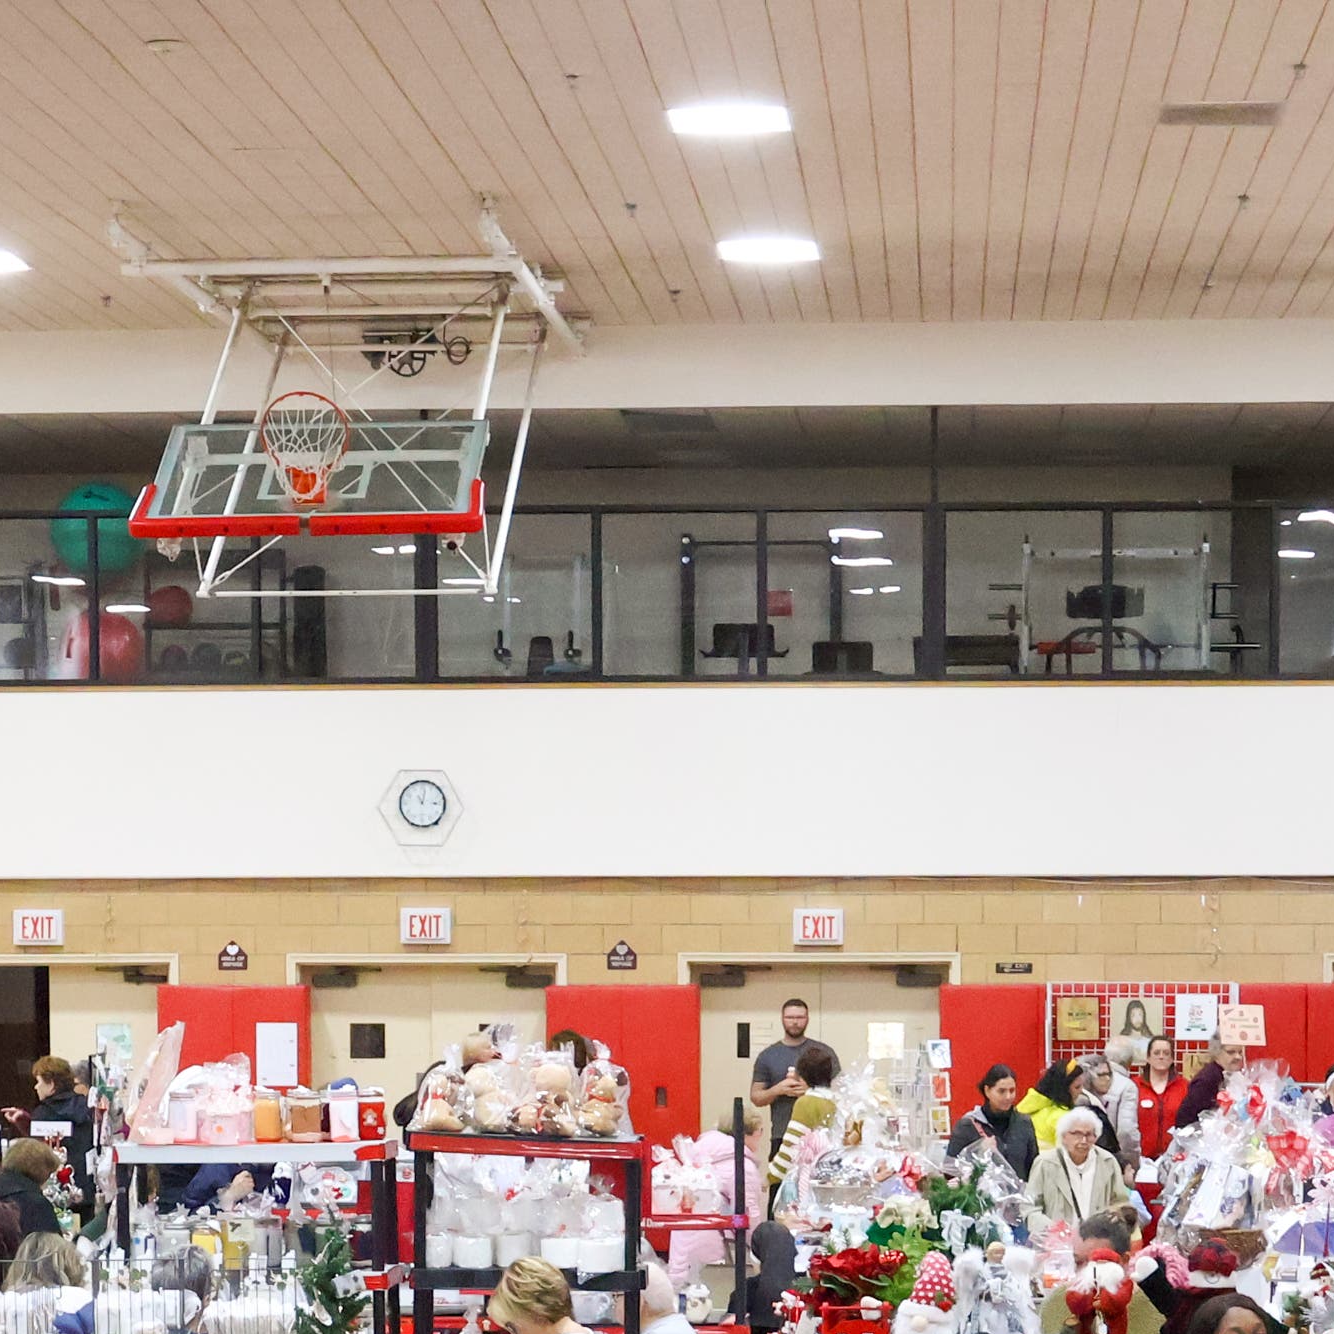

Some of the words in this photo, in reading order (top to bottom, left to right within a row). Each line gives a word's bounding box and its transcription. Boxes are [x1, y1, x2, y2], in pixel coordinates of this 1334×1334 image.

[21, 916, 53, 940] EXIT
[409, 915, 442, 938] EXIT
[801, 915, 836, 939] EXIT
